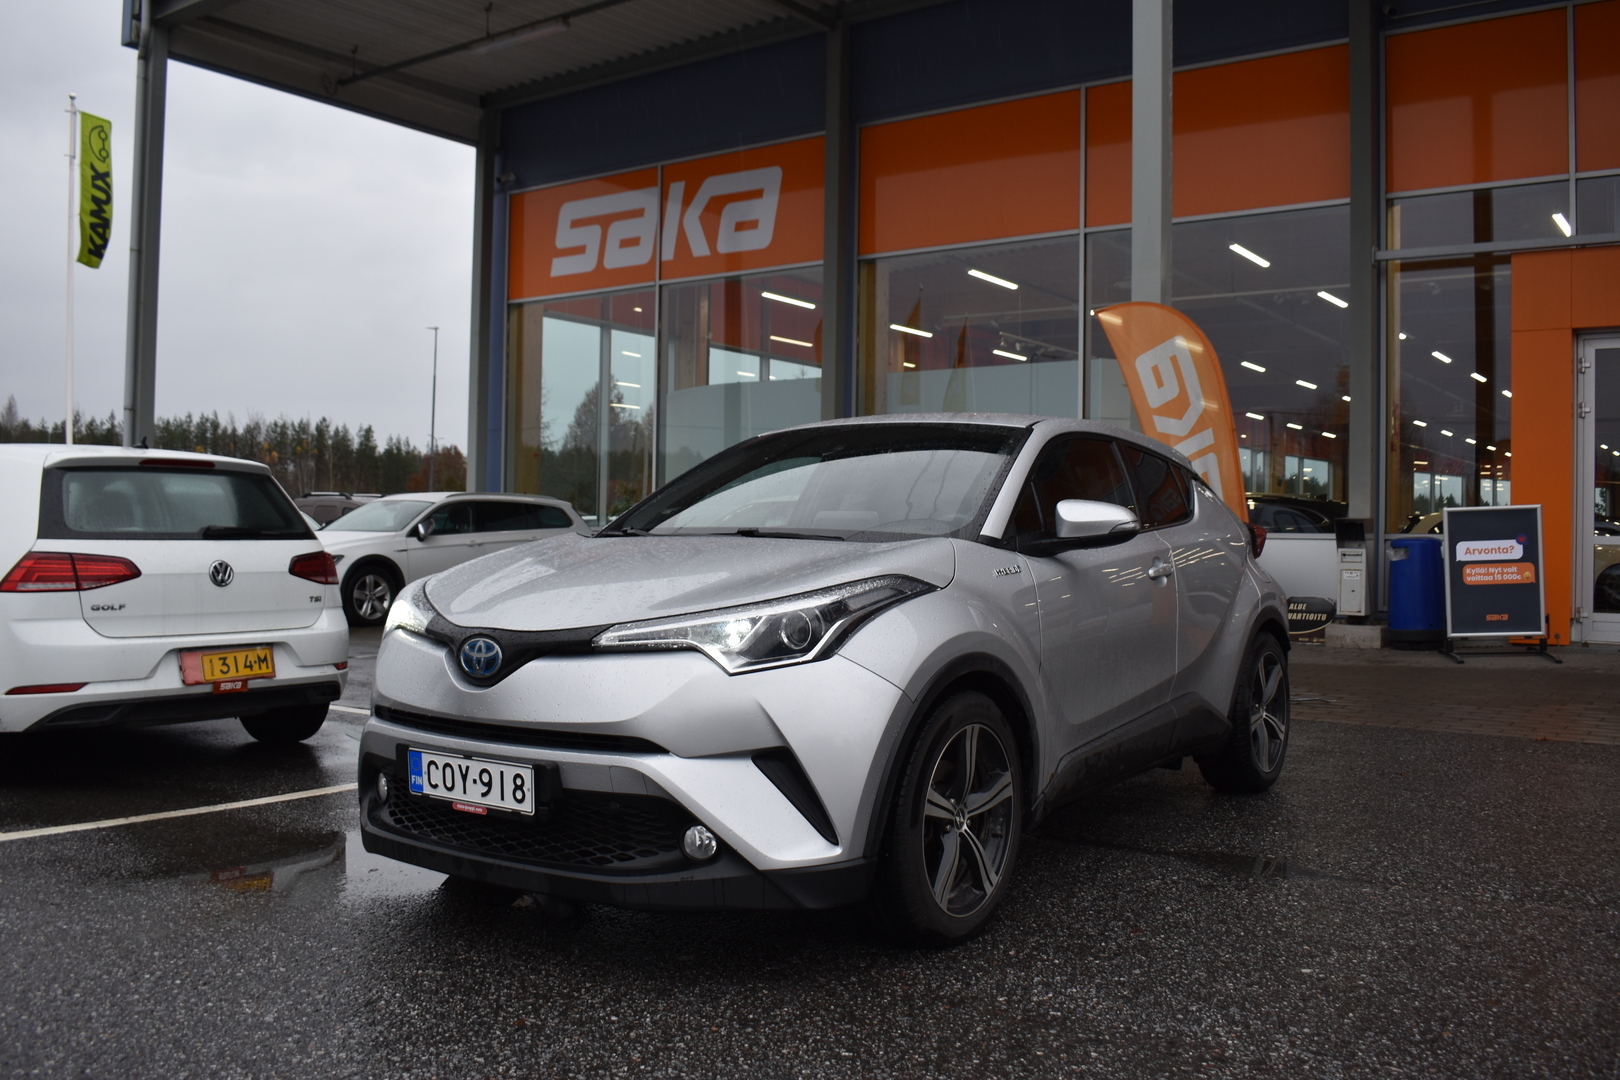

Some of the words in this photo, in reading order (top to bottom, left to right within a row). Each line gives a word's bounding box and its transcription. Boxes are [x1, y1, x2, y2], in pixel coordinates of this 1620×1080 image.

[87, 162, 112, 260] KAMUX
[1464, 545, 1515, 555] Arvonta?
[1489, 566, 1502, 575] Nyt
[1466, 574, 1493, 582] voittaa
[309, 595, 322, 603] TSI
[90, 603, 126, 612] GOLF
[1287, 612, 1327, 621] VARTIOITU
[411, 775, 423, 786] FIN
[427, 759, 525, 804] COY-918
